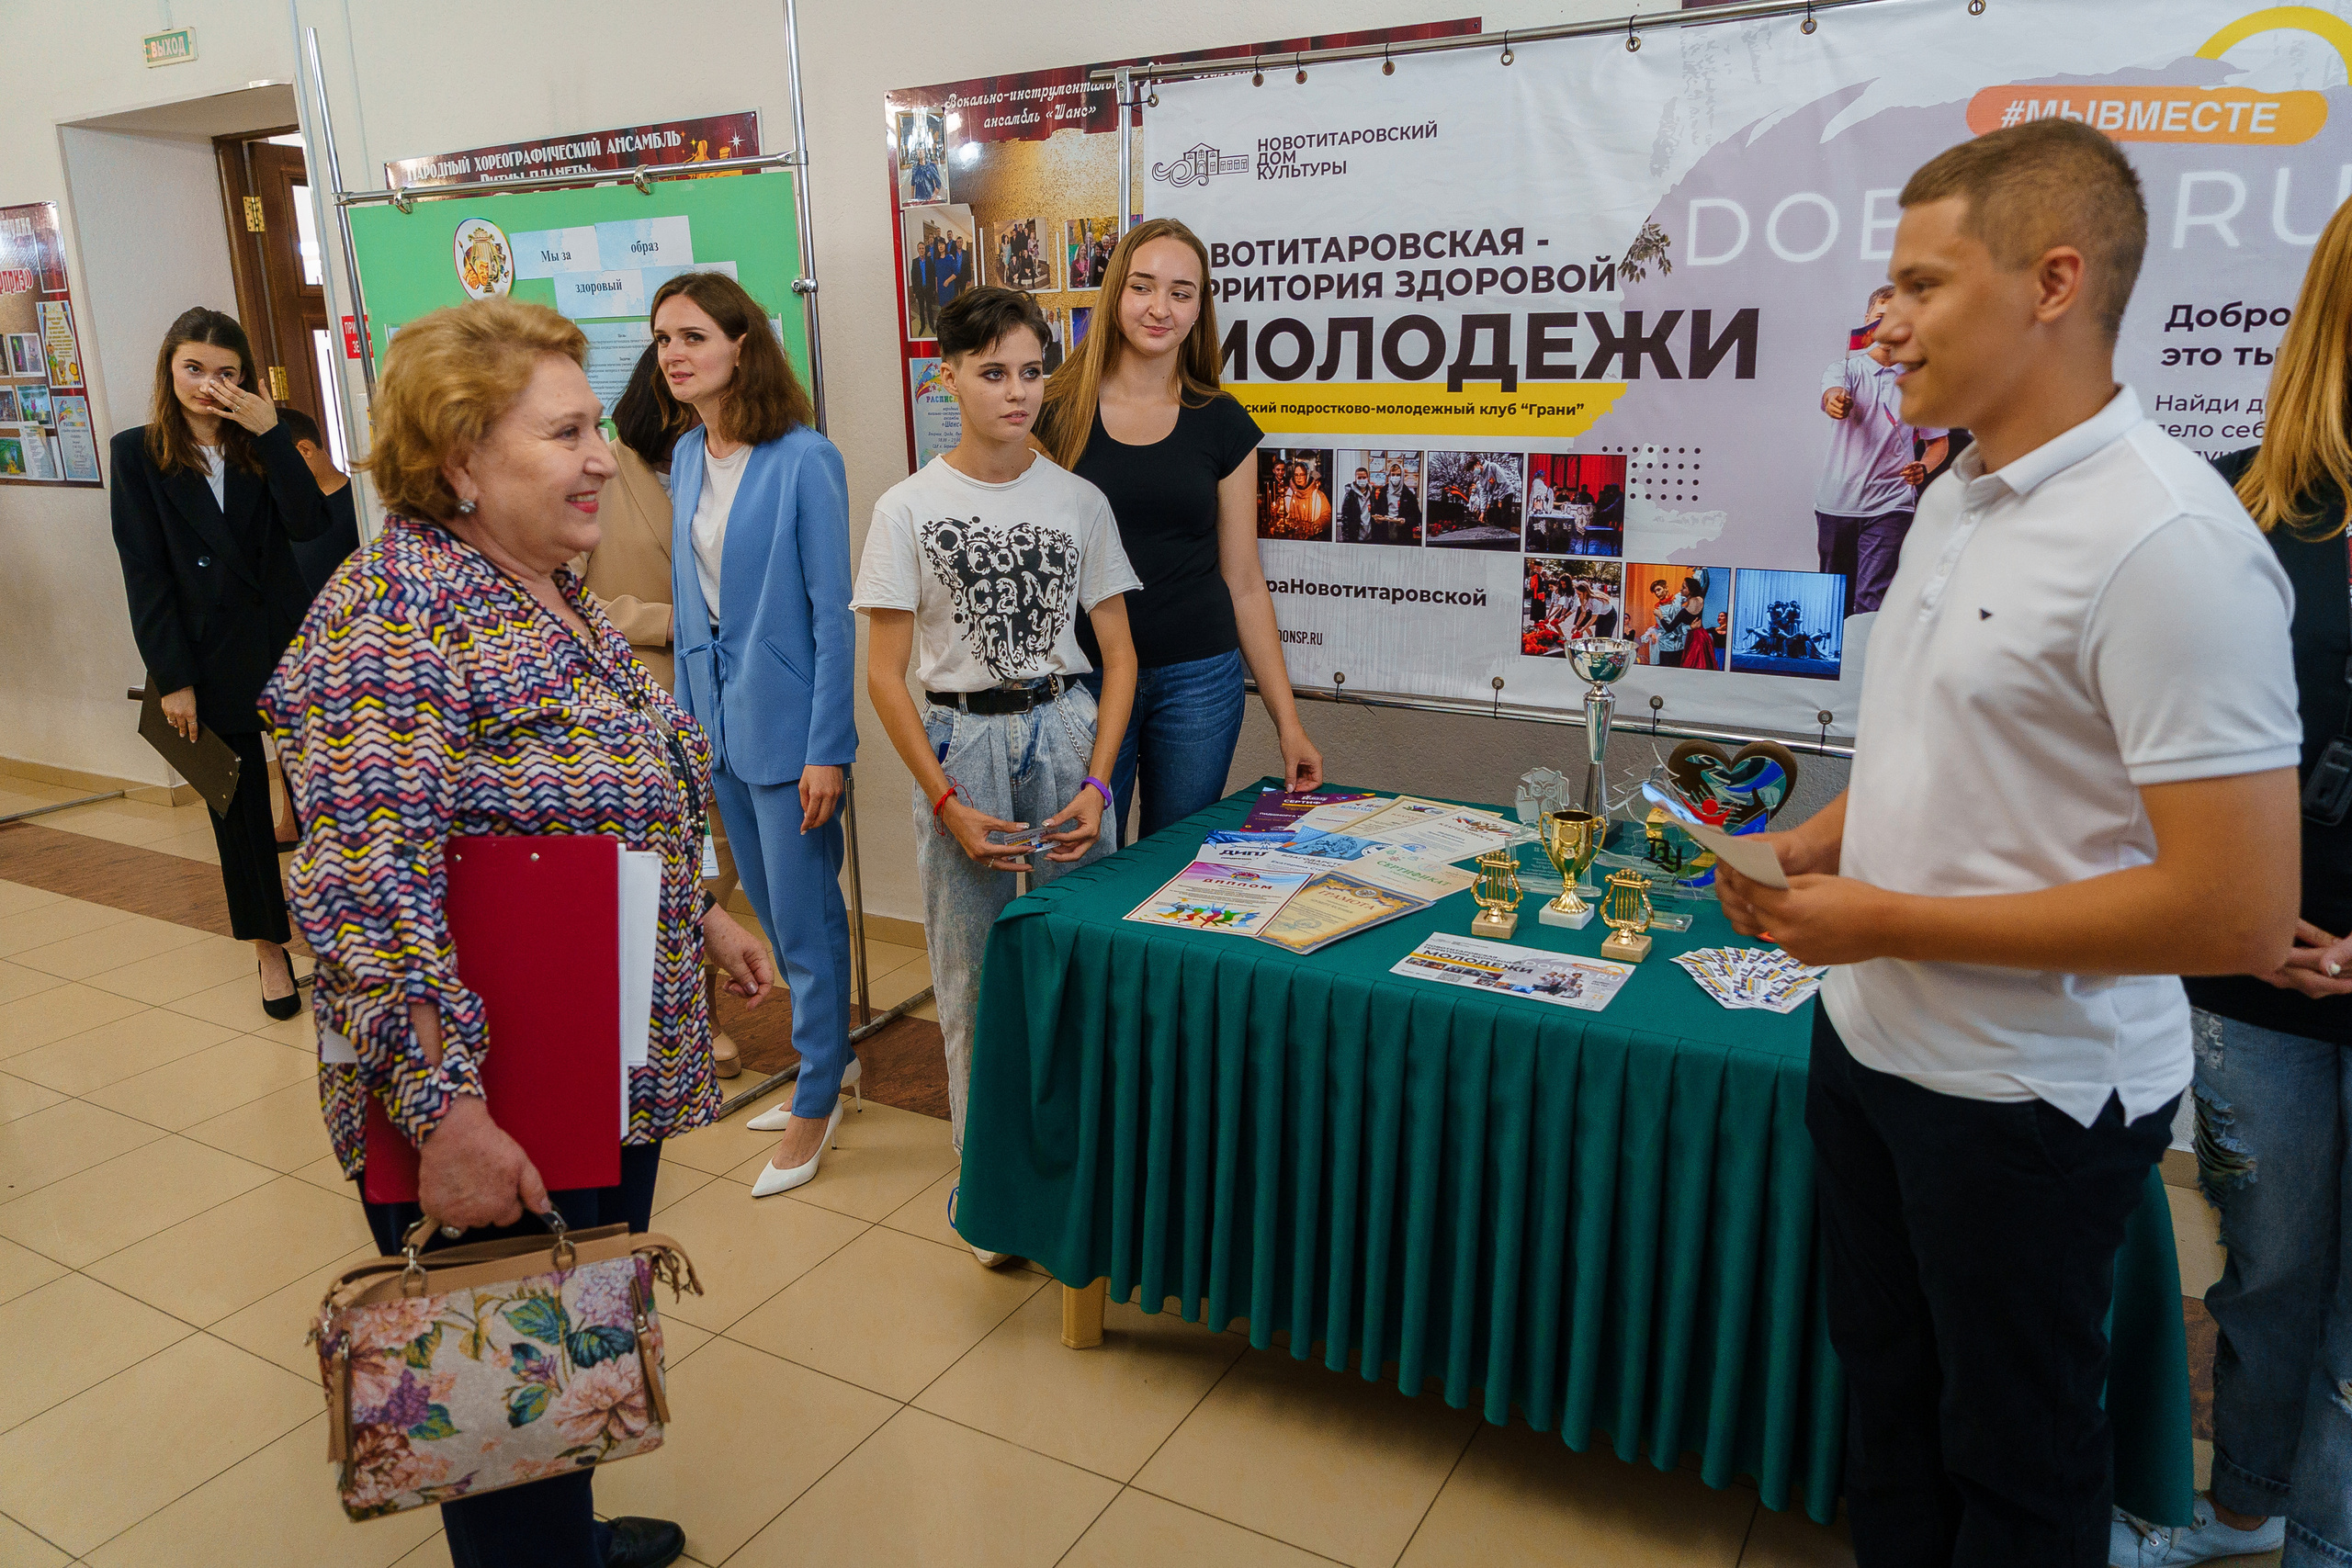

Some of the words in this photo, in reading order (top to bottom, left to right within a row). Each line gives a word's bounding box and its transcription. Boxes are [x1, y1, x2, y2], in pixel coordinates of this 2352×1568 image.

[150, 36, 187, 58] ВЫХОД
[984, 107, 1040, 129] ансамбль
[1046, 103, 1097, 120] «Шанс»
[1257, 120, 1439, 152] НОВОТИТАРОВСКИЙ
[407, 155, 471, 181] НАРОДНЫЙ
[473, 137, 601, 172] ХОРЕОГРАФИЧЕСКИЙ
[606, 130, 682, 154] АНСАМБЛЬ
[1257, 151, 1296, 168] ДОМ
[1257, 161, 1348, 181] КУЛЬТУРЫ
[540, 250, 559, 264] Мы
[561, 251, 572, 262] за
[630, 240, 660, 256] образ
[1209, 226, 1524, 268] ВОТИТАРОВСКАЯ
[575, 278, 623, 296] здоровый
[1395, 255, 1617, 302] ЗДОРОВОЙ
[2160, 347, 2222, 367] это
[1280, 401, 1475, 417] подростково-молодежный
[1479, 401, 1517, 417] клуб
[1521, 402, 1585, 418] “Грани”
[2154, 394, 2240, 414] Найди
[2221, 421, 2267, 438] себ
[1265, 579, 1487, 606] раНовотитаровской
[1376, 860, 1453, 886] СЕРТИФИКАТ
[1202, 878, 1273, 890] ДИПЛОМ
[1317, 889, 1375, 910] ГРАМОТА
[1423, 950, 1534, 974] МОЛОДЕЖИ
